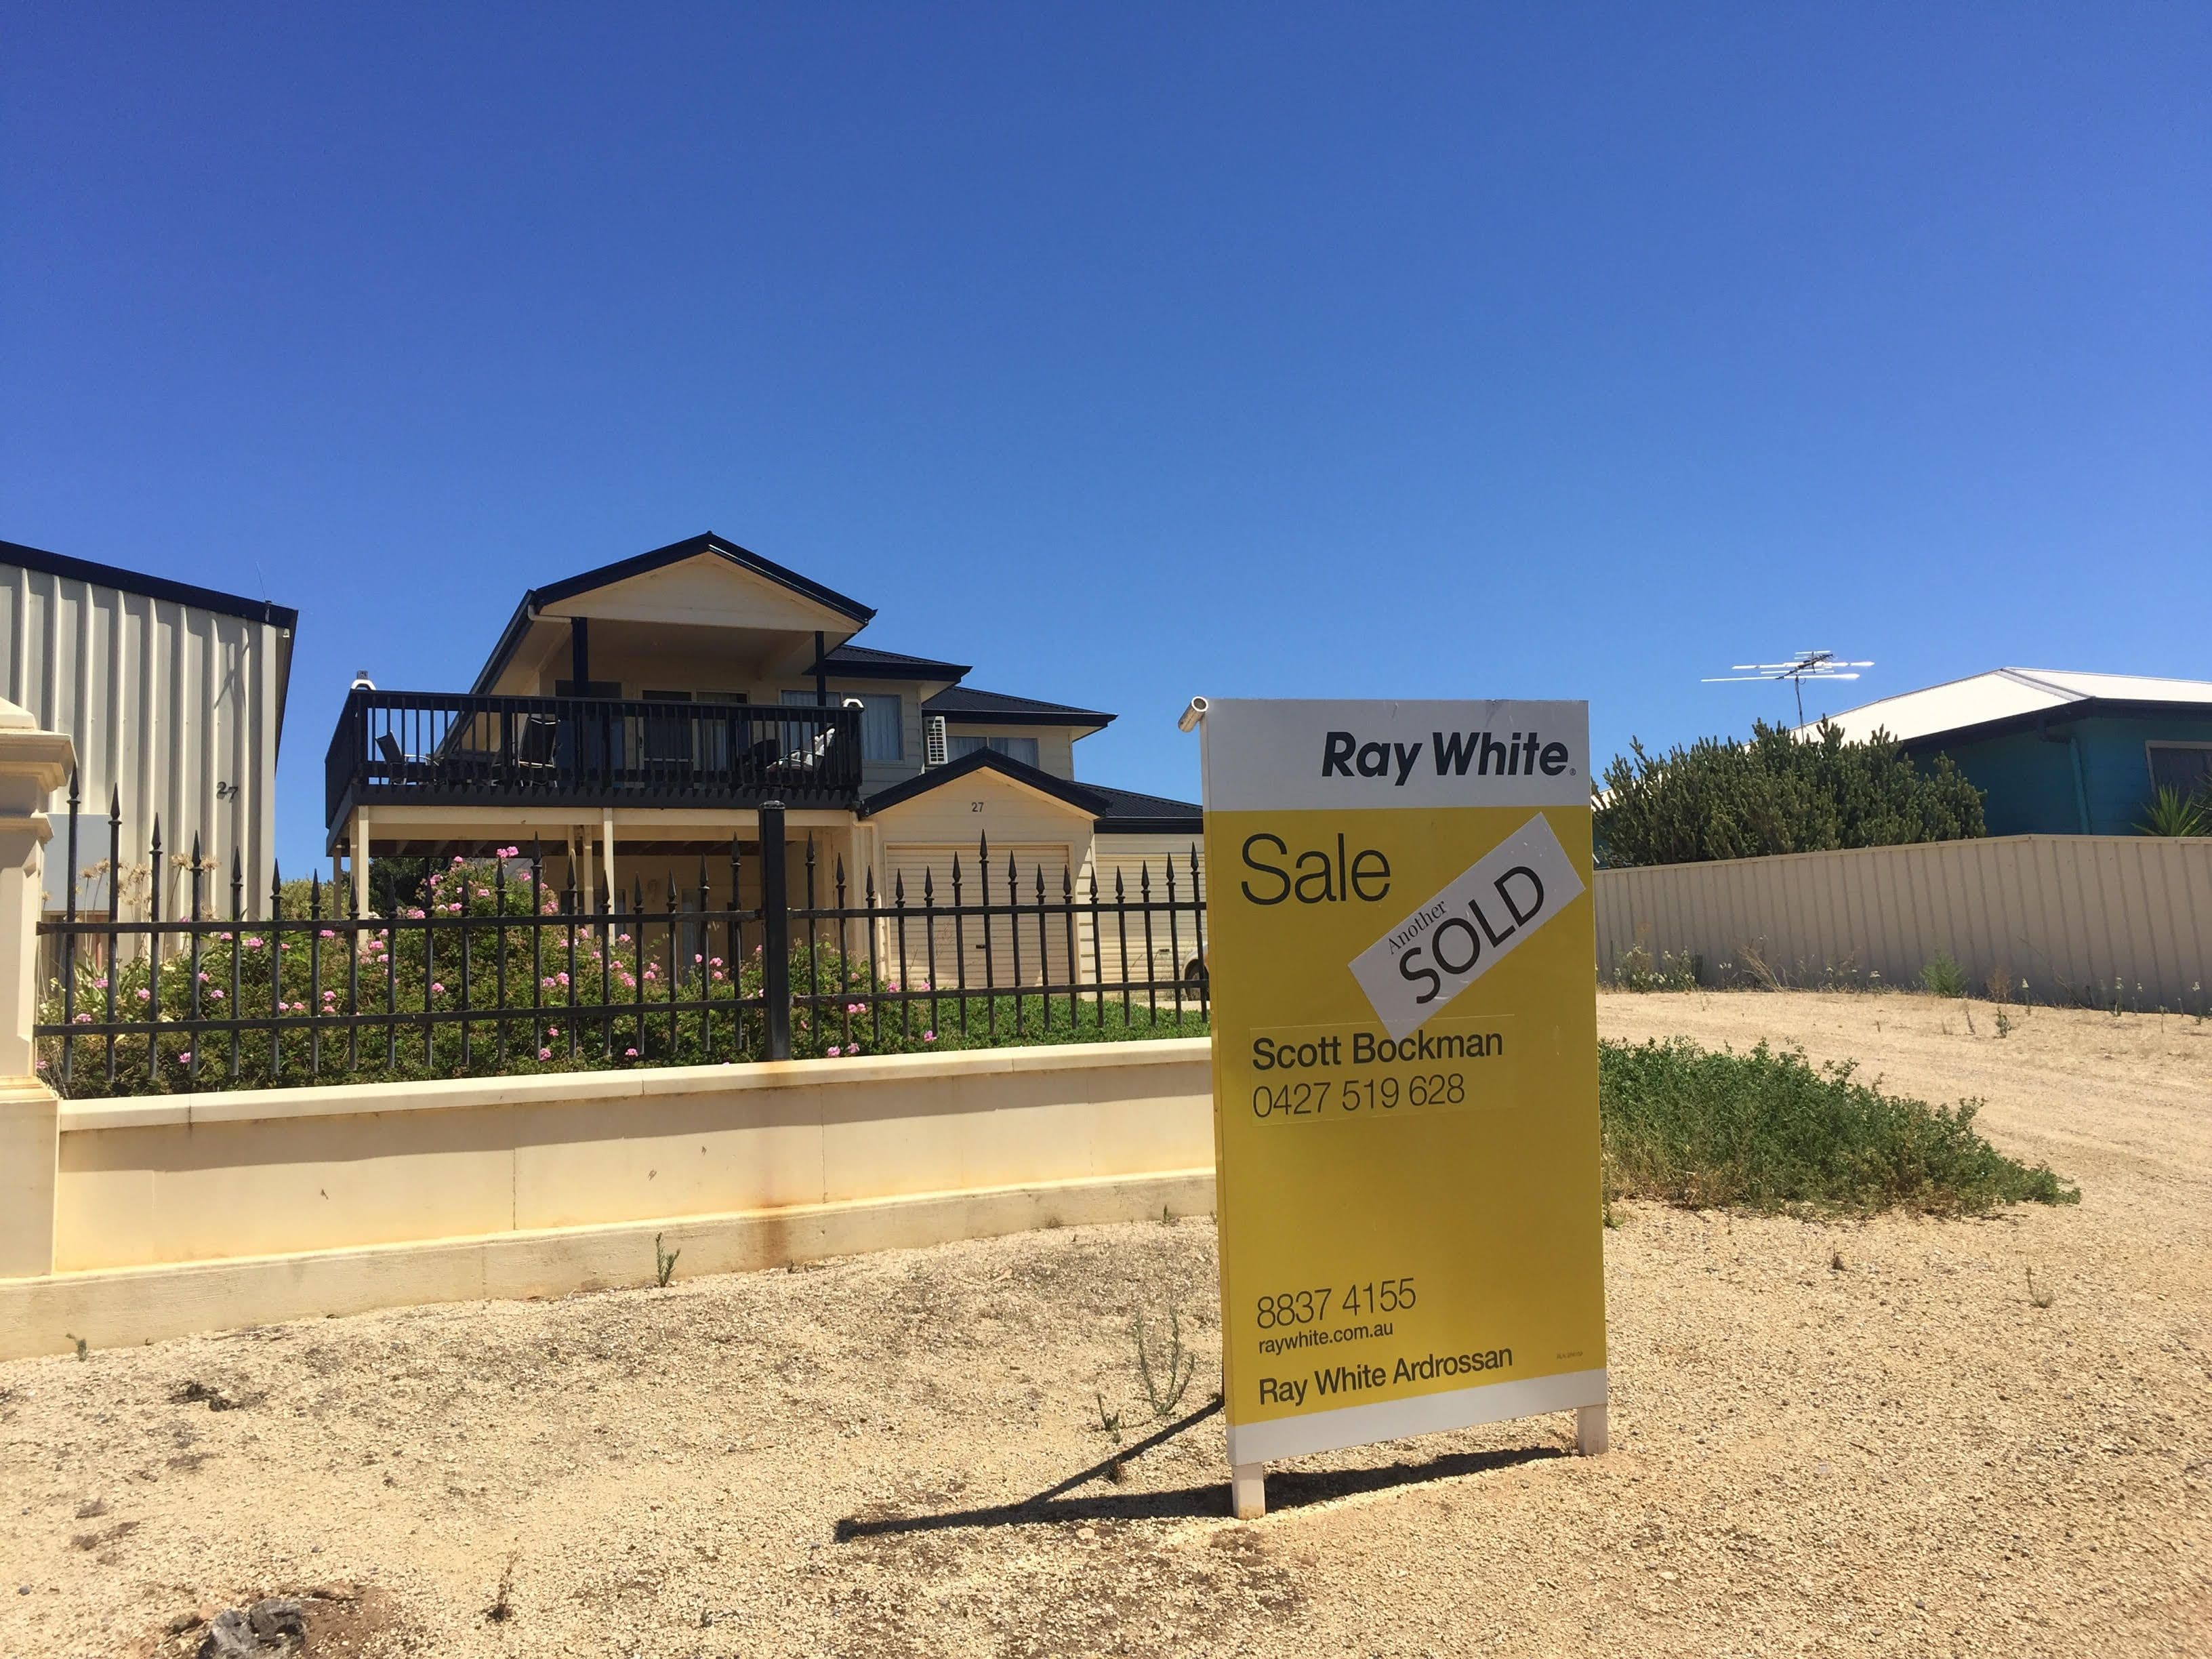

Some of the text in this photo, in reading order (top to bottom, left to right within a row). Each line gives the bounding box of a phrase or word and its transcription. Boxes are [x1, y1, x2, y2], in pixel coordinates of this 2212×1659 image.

[1322, 731, 1569, 786] Ray White
[216, 781, 239, 800] 27
[971, 802, 984, 813] 27
[1241, 833, 1391, 905] Sale
[1387, 901, 1448, 955] Another
[1399, 866, 1544, 1004] SOLD
[1252, 1029, 1503, 1071] Scott Bockman
[1252, 1073, 1465, 1118] 0427 519 628
[1256, 1277, 1416, 1329] 8837 4155
[1258, 1322, 1394, 1355] raywhite.com.au
[1258, 1347, 1513, 1408] Ray White Ardrossan
